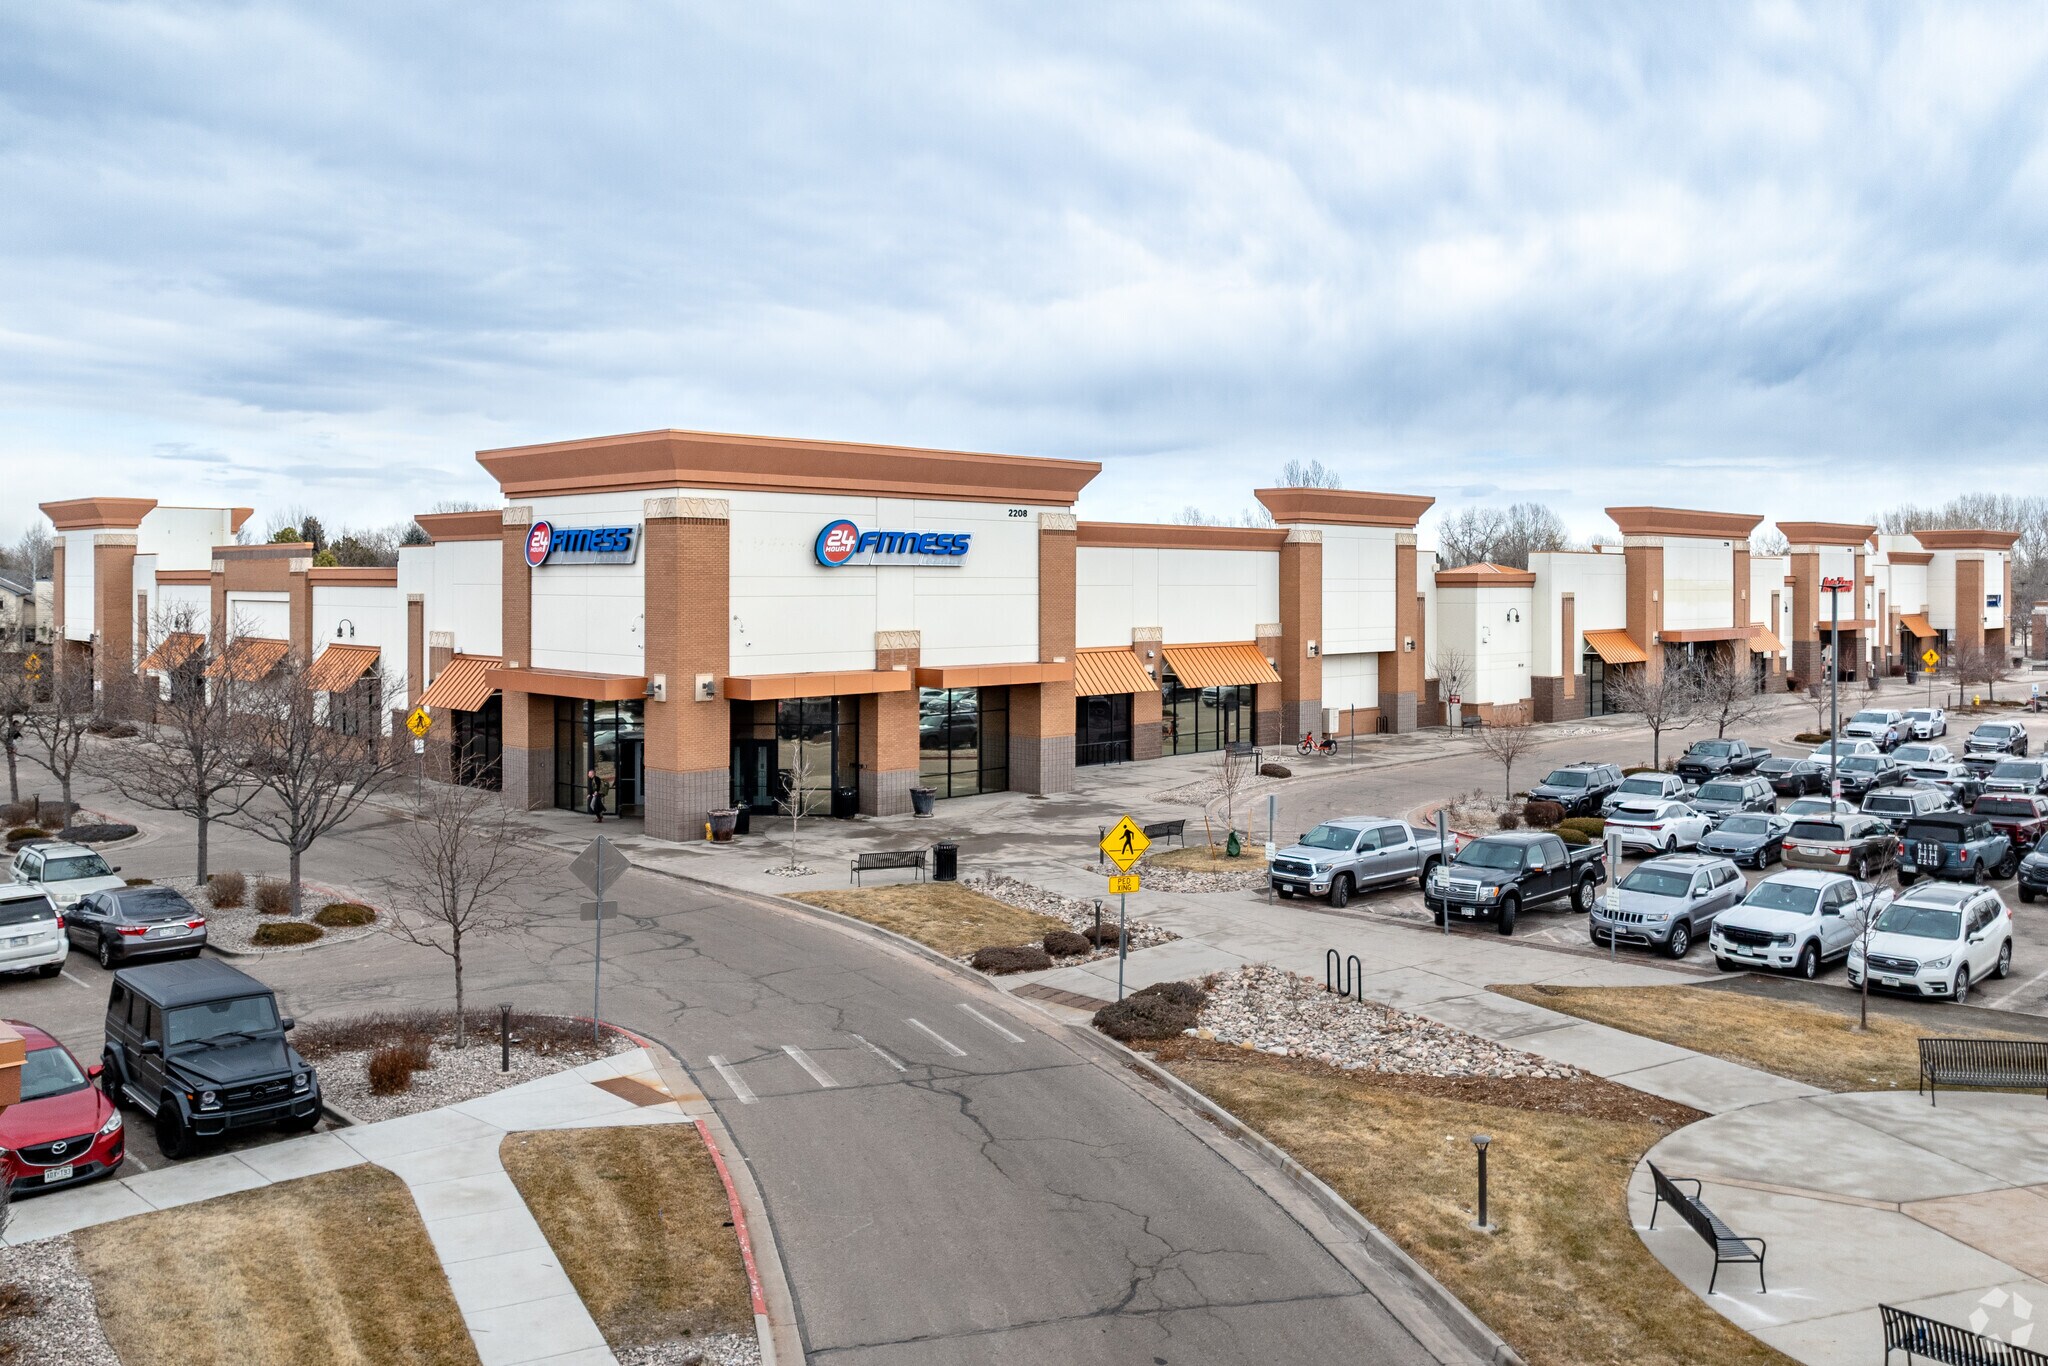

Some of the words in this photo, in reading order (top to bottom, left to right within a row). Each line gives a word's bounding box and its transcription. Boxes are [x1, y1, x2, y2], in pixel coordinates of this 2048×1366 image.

[1008, 509, 1028, 518] 2208
[531, 531, 548, 552] 24
[550, 528, 632, 552] FITNESS
[826, 530, 856, 551] 24
[857, 532, 972, 555] FITNESS
[1117, 877, 1131, 885] PED
